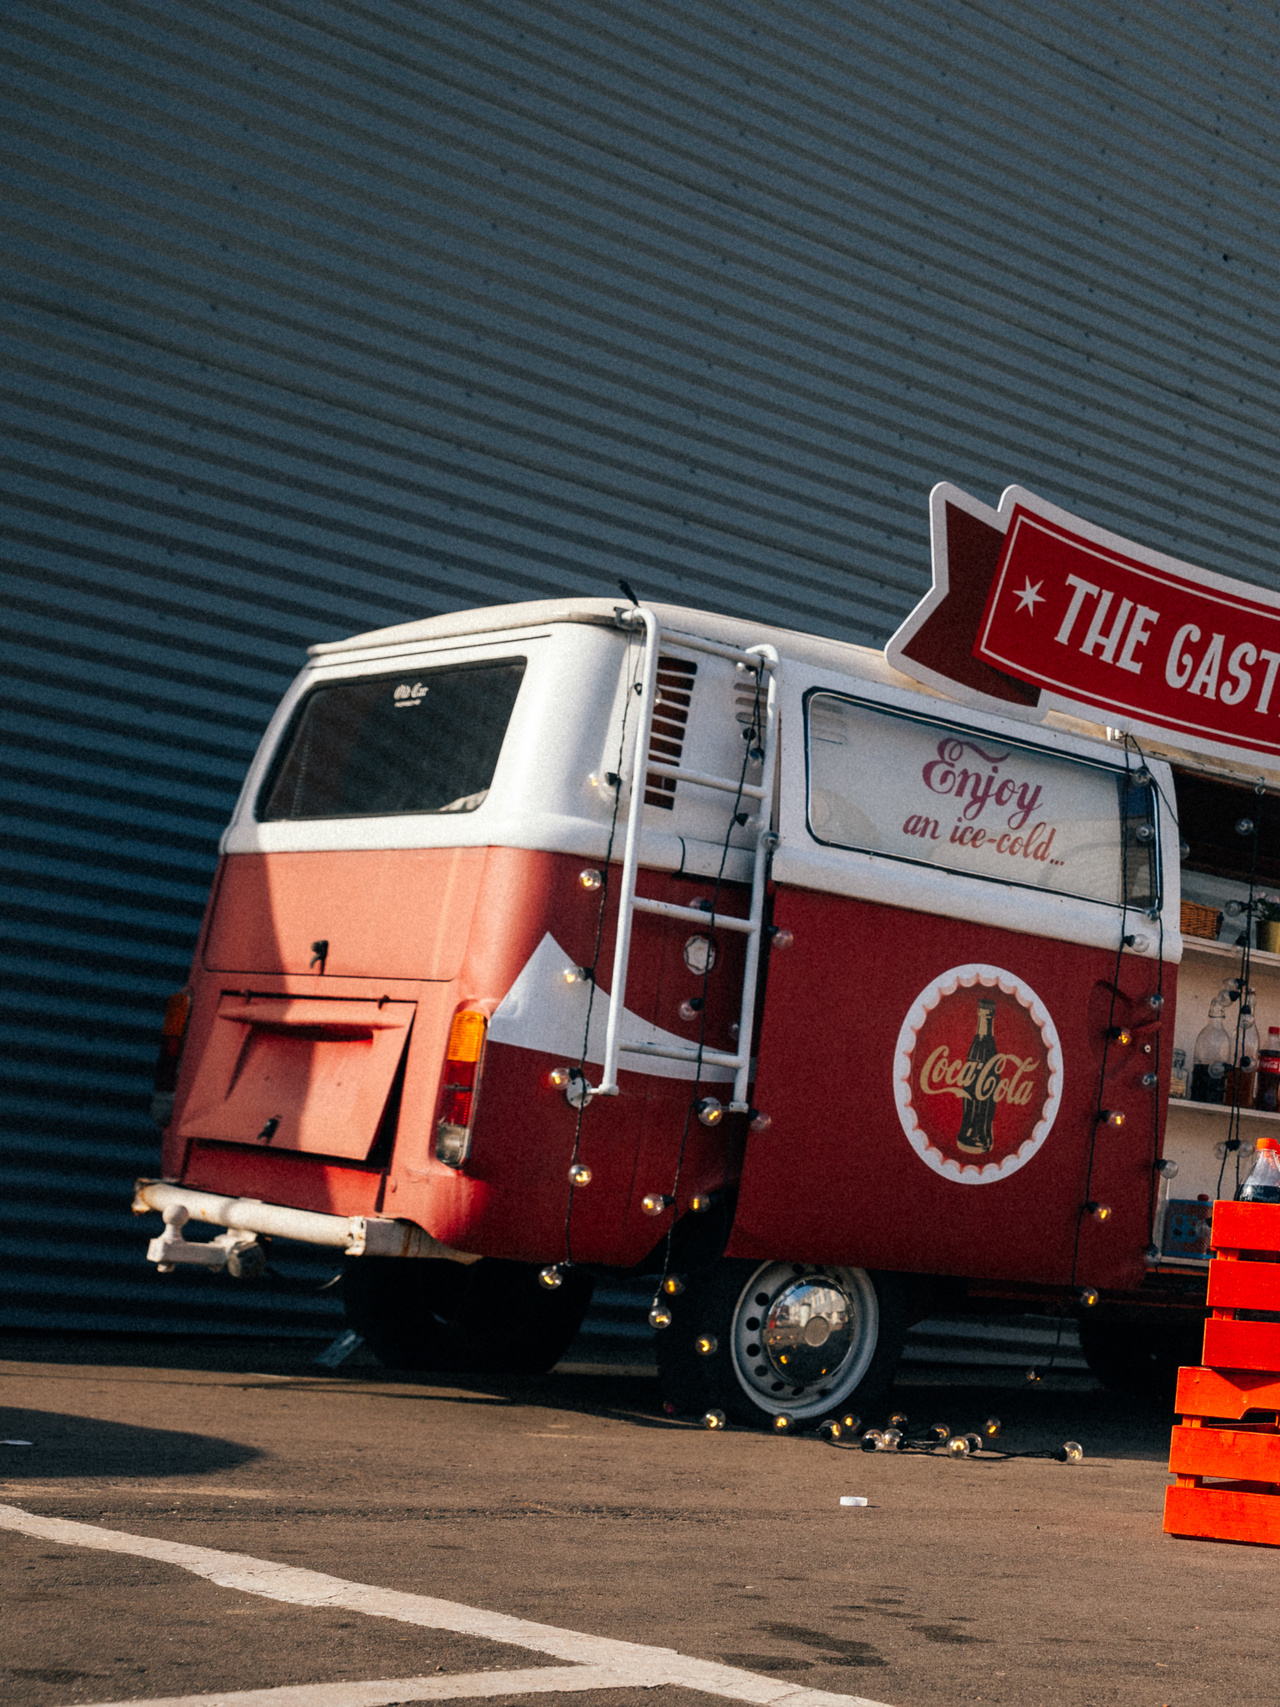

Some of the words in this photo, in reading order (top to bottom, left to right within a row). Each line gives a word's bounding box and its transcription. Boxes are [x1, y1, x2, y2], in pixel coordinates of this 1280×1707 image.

[1054, 573, 1160, 675] THE
[922, 737, 1043, 830] Enjoy
[903, 814, 941, 840] an
[950, 816, 1065, 866] ice-cold...
[920, 1045, 1040, 1106] Coca-Cola
